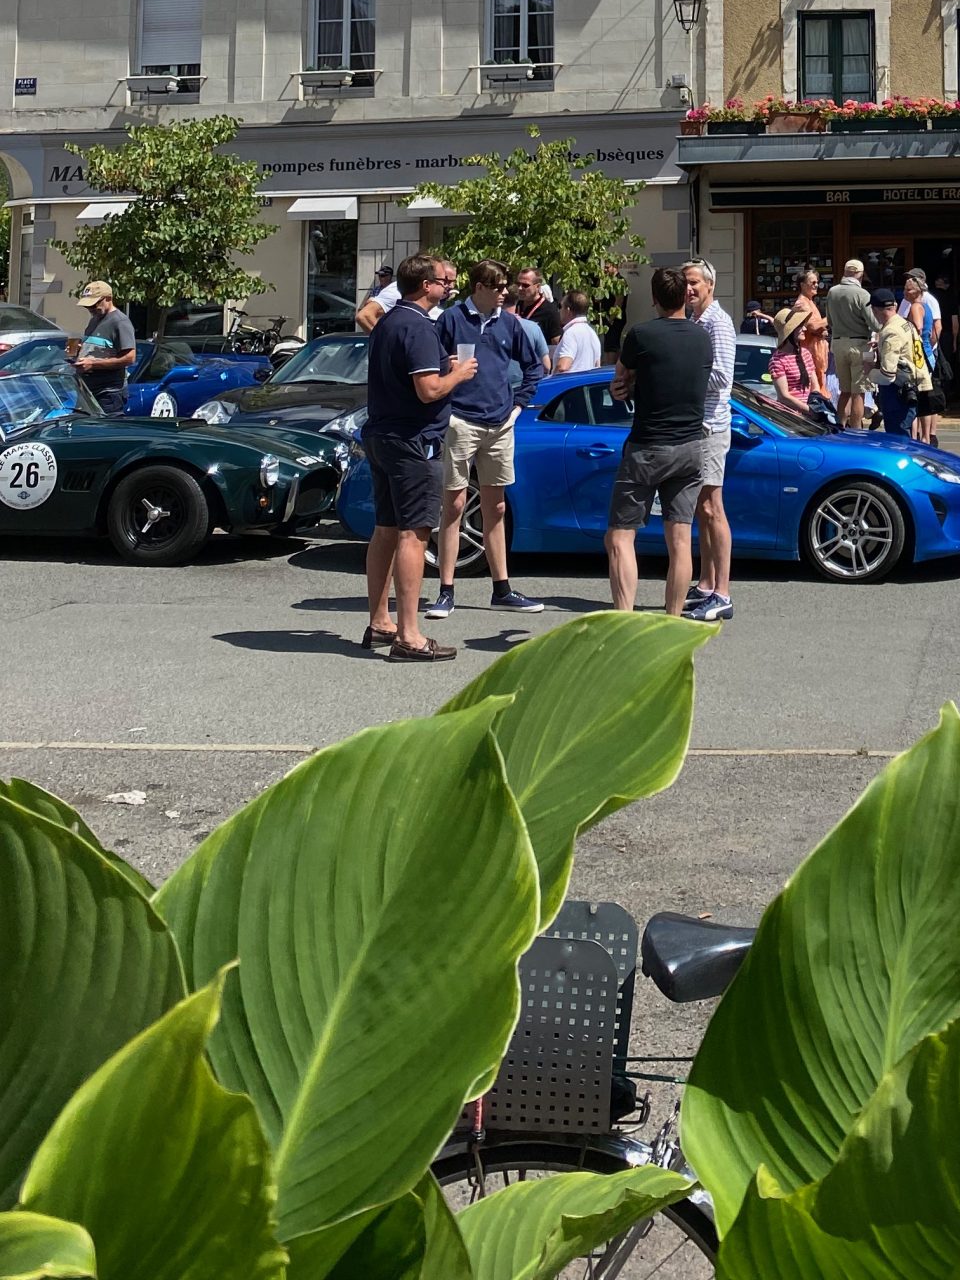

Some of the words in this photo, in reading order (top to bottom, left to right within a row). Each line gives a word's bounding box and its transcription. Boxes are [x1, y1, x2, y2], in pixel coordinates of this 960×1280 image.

[262, 160, 324, 176] pompes
[330, 157, 401, 172] funèbres
[826, 191, 850, 203] BAR
[883, 189, 921, 200] HOTEL
[924, 188, 939, 199] DE
[3, 444, 29, 459] MANS
[32, 444, 55, 471] CLASSIC
[10, 462, 39, 488] 26
